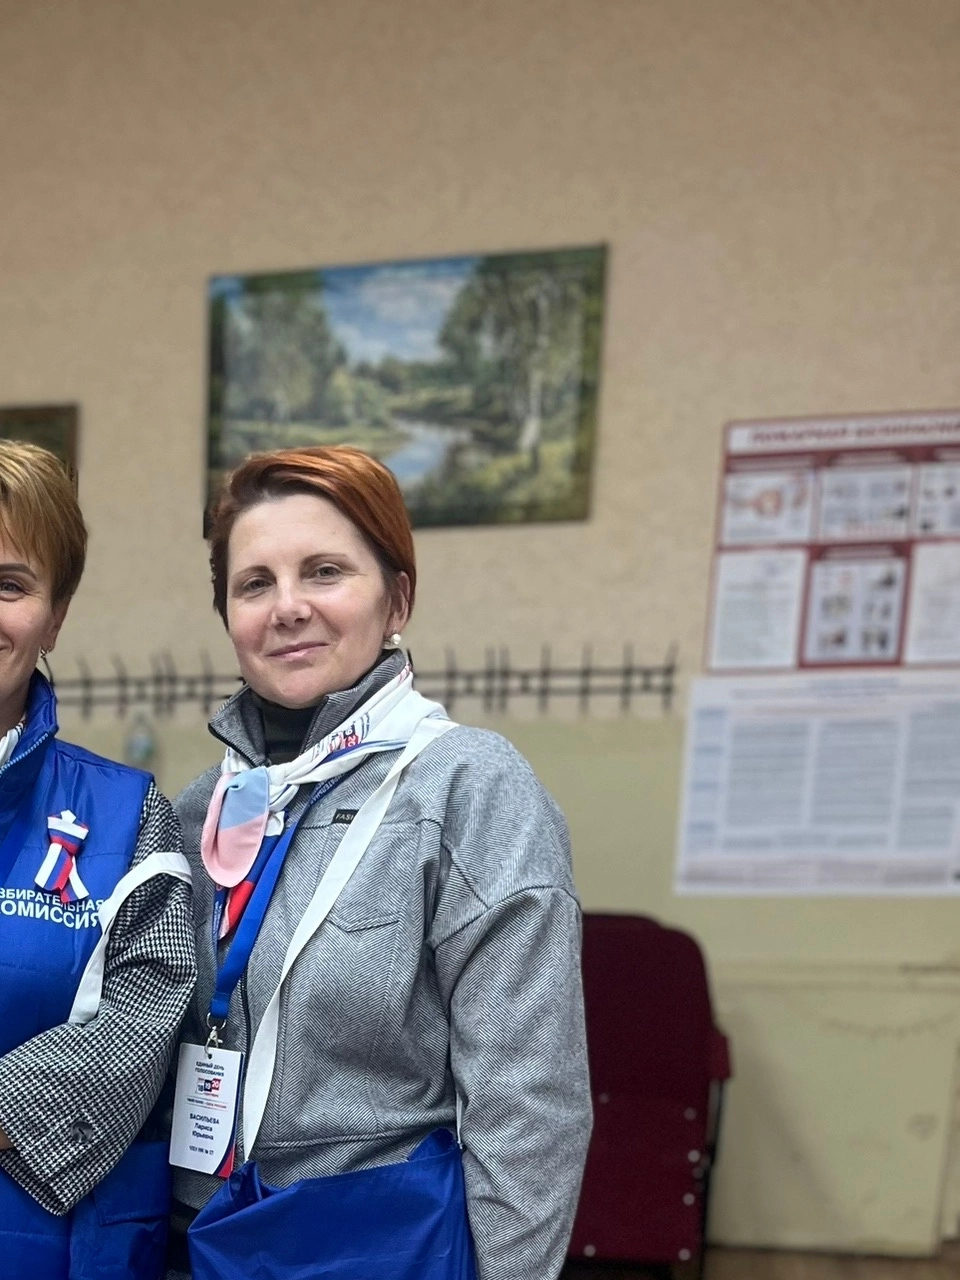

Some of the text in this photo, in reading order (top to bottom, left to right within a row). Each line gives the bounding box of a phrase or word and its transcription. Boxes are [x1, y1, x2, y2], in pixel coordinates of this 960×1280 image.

[211, 1080, 220, 1089] 20
[190, 1113, 220, 1124] ВАСИЛЬЕВА
[195, 1122, 213, 1131] Лариса
[192, 1130, 214, 1140] Юрьевна
